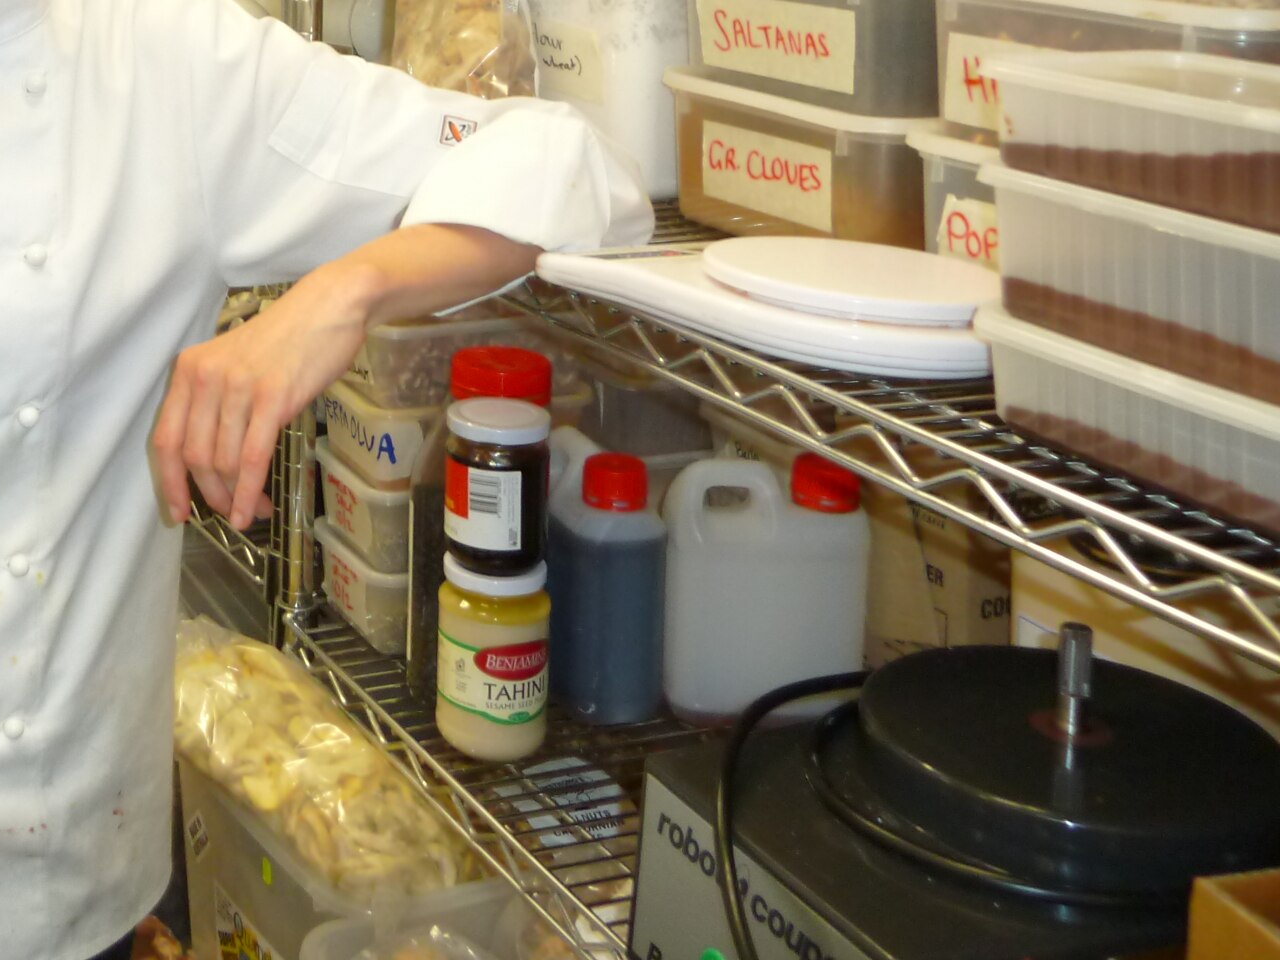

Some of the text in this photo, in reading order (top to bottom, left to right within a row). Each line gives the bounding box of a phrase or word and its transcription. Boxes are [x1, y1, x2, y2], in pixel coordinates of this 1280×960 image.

[533, 22, 562, 51] lour
[713, 9, 830, 59] SALTANAS
[746, 149, 822, 194] CLOVES
[946, 210, 999, 260] POP
[483, 674, 545, 701] TAHINI
[485, 701, 515, 710] SESAME
[657, 812, 720, 877] robo
